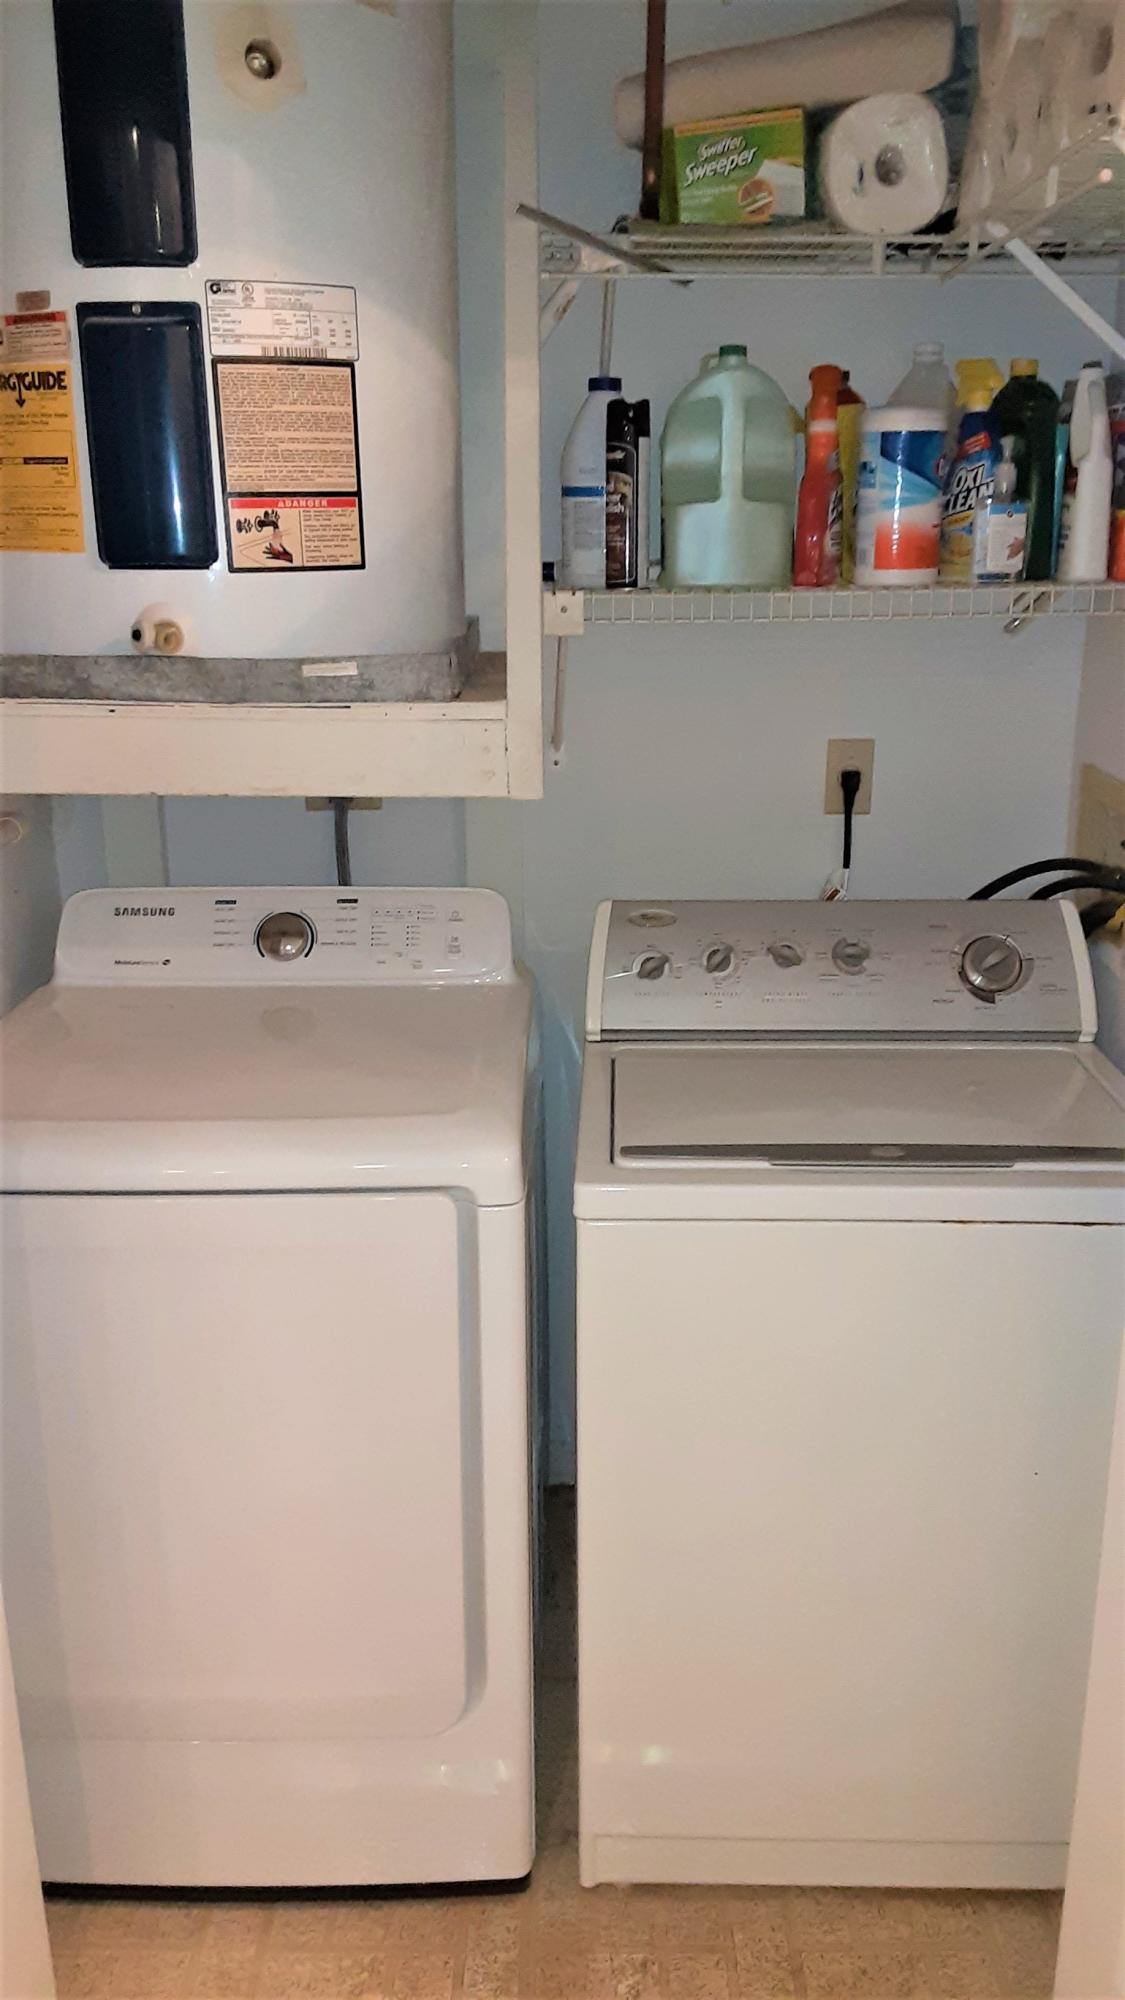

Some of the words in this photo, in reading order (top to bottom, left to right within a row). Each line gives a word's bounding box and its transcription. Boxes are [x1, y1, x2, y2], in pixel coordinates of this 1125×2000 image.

[700, 136, 745, 160] Swiffer
[684, 146, 758, 189] Sweeper
[952, 463, 986, 495] OXI
[114, 907, 175, 917] SAMSUNG
